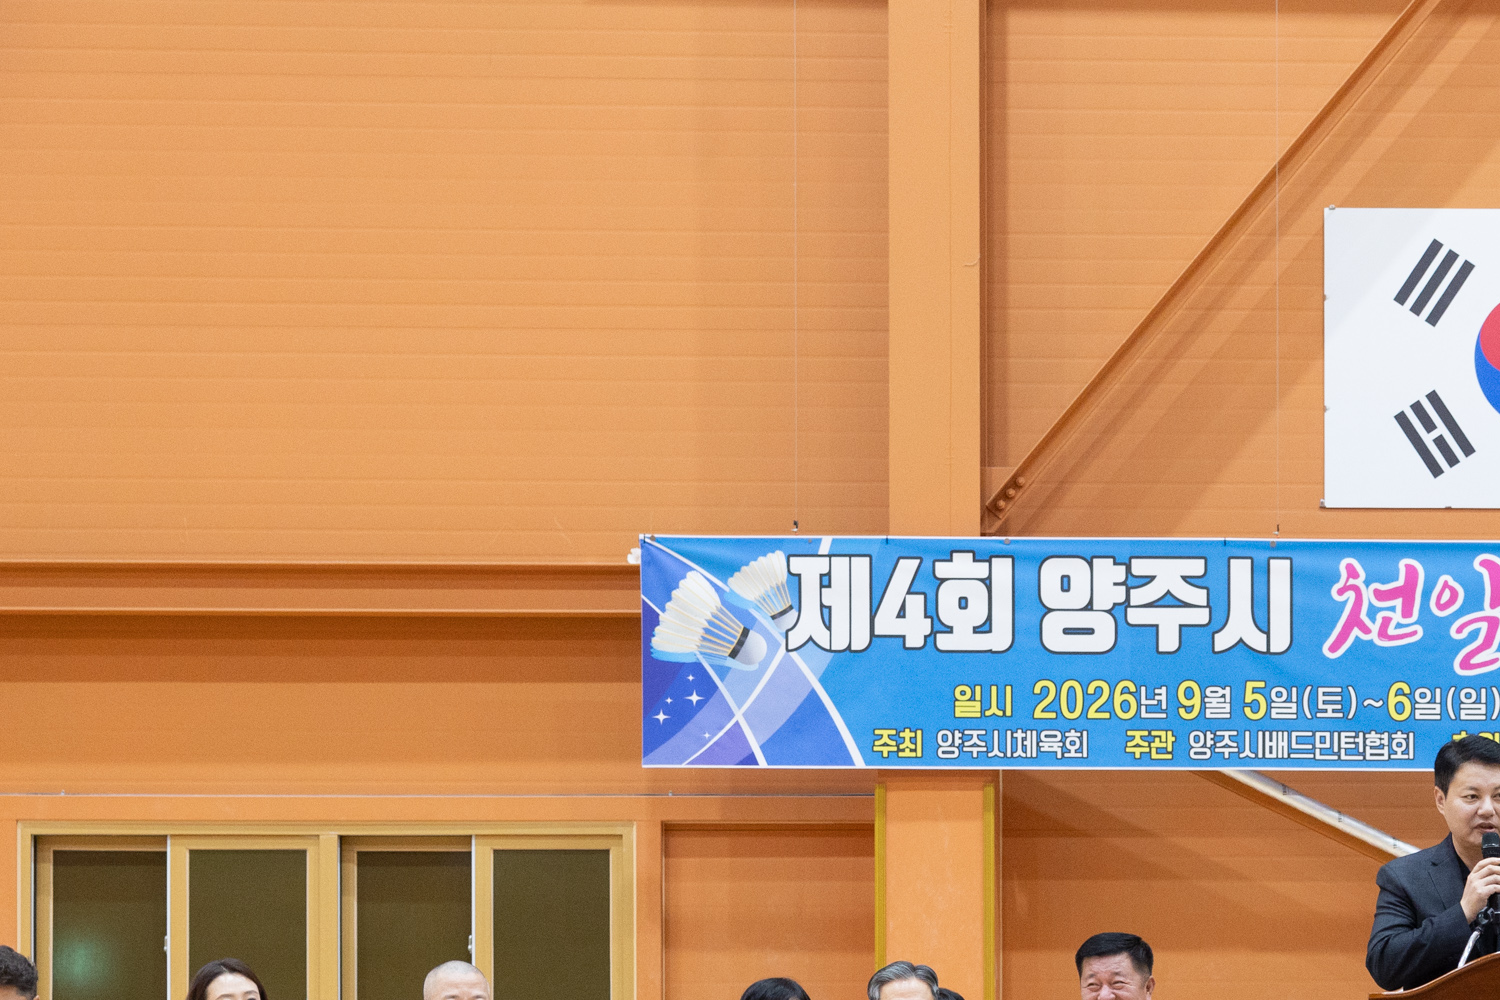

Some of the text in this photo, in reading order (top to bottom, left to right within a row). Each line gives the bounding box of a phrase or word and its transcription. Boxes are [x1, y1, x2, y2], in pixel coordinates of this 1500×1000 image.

[786, 550, 1014, 654] 제4회
[1039, 555, 1293, 655] 양주시
[953, 684, 1013, 718] 일시
[1033, 679, 1168, 720] 2026년
[1176, 679, 1232, 720] 9월
[872, 728, 923, 758] 주최
[936, 728, 1088, 759] 양주시체육회
[1125, 729, 1176, 760] 주관
[1188, 730, 1414, 761] 양주시배드민턴협회
